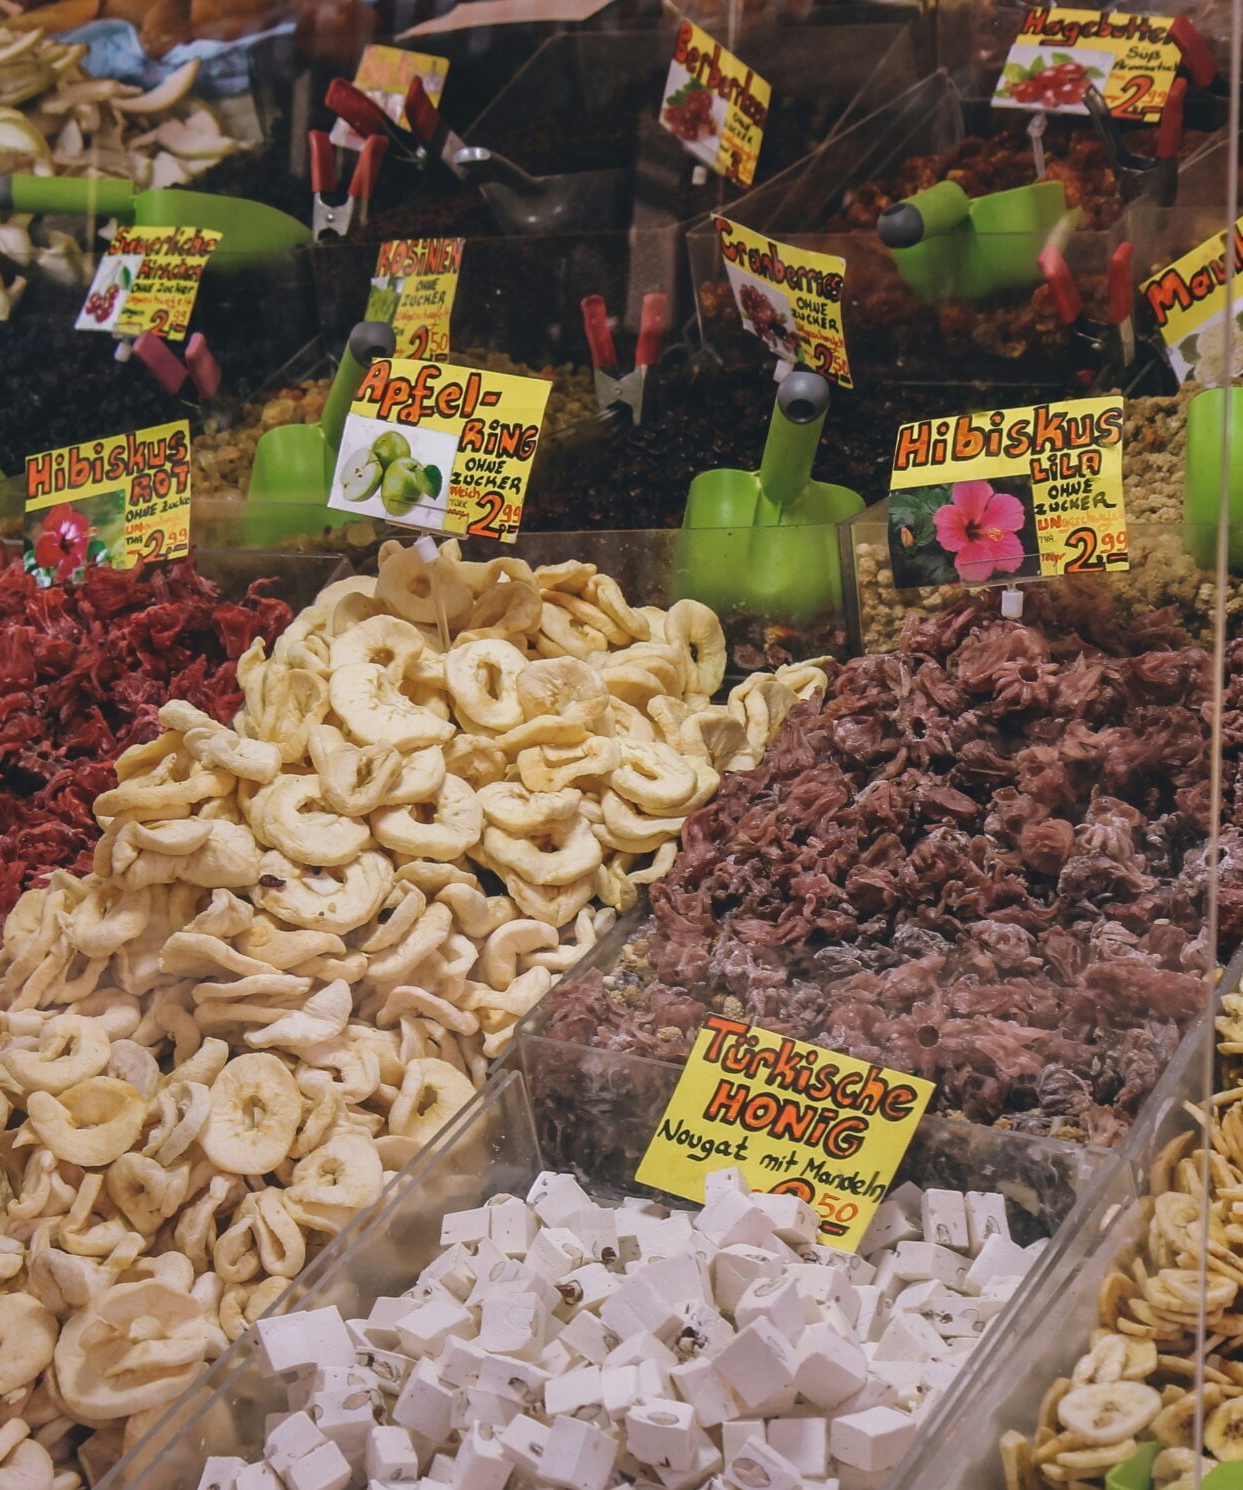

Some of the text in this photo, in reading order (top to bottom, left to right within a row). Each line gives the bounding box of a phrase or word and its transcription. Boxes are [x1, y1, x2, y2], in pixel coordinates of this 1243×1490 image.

[796, 297, 828, 317] OHNE
[893, 403, 1124, 471] Hibiskus
[27, 430, 190, 500] Hibiskus
[464, 457, 507, 475] OHNE
[128, 460, 191, 507] ROT
[450, 471, 522, 495] ZUCKER
[1047, 476, 1094, 499] OHNE
[125, 502, 158, 523] OHNE
[1032, 491, 1118, 516] ZUCKER
[702, 1015, 919, 1121] Türkische
[657, 1118, 888, 1204] Nougat mit Mandeln
